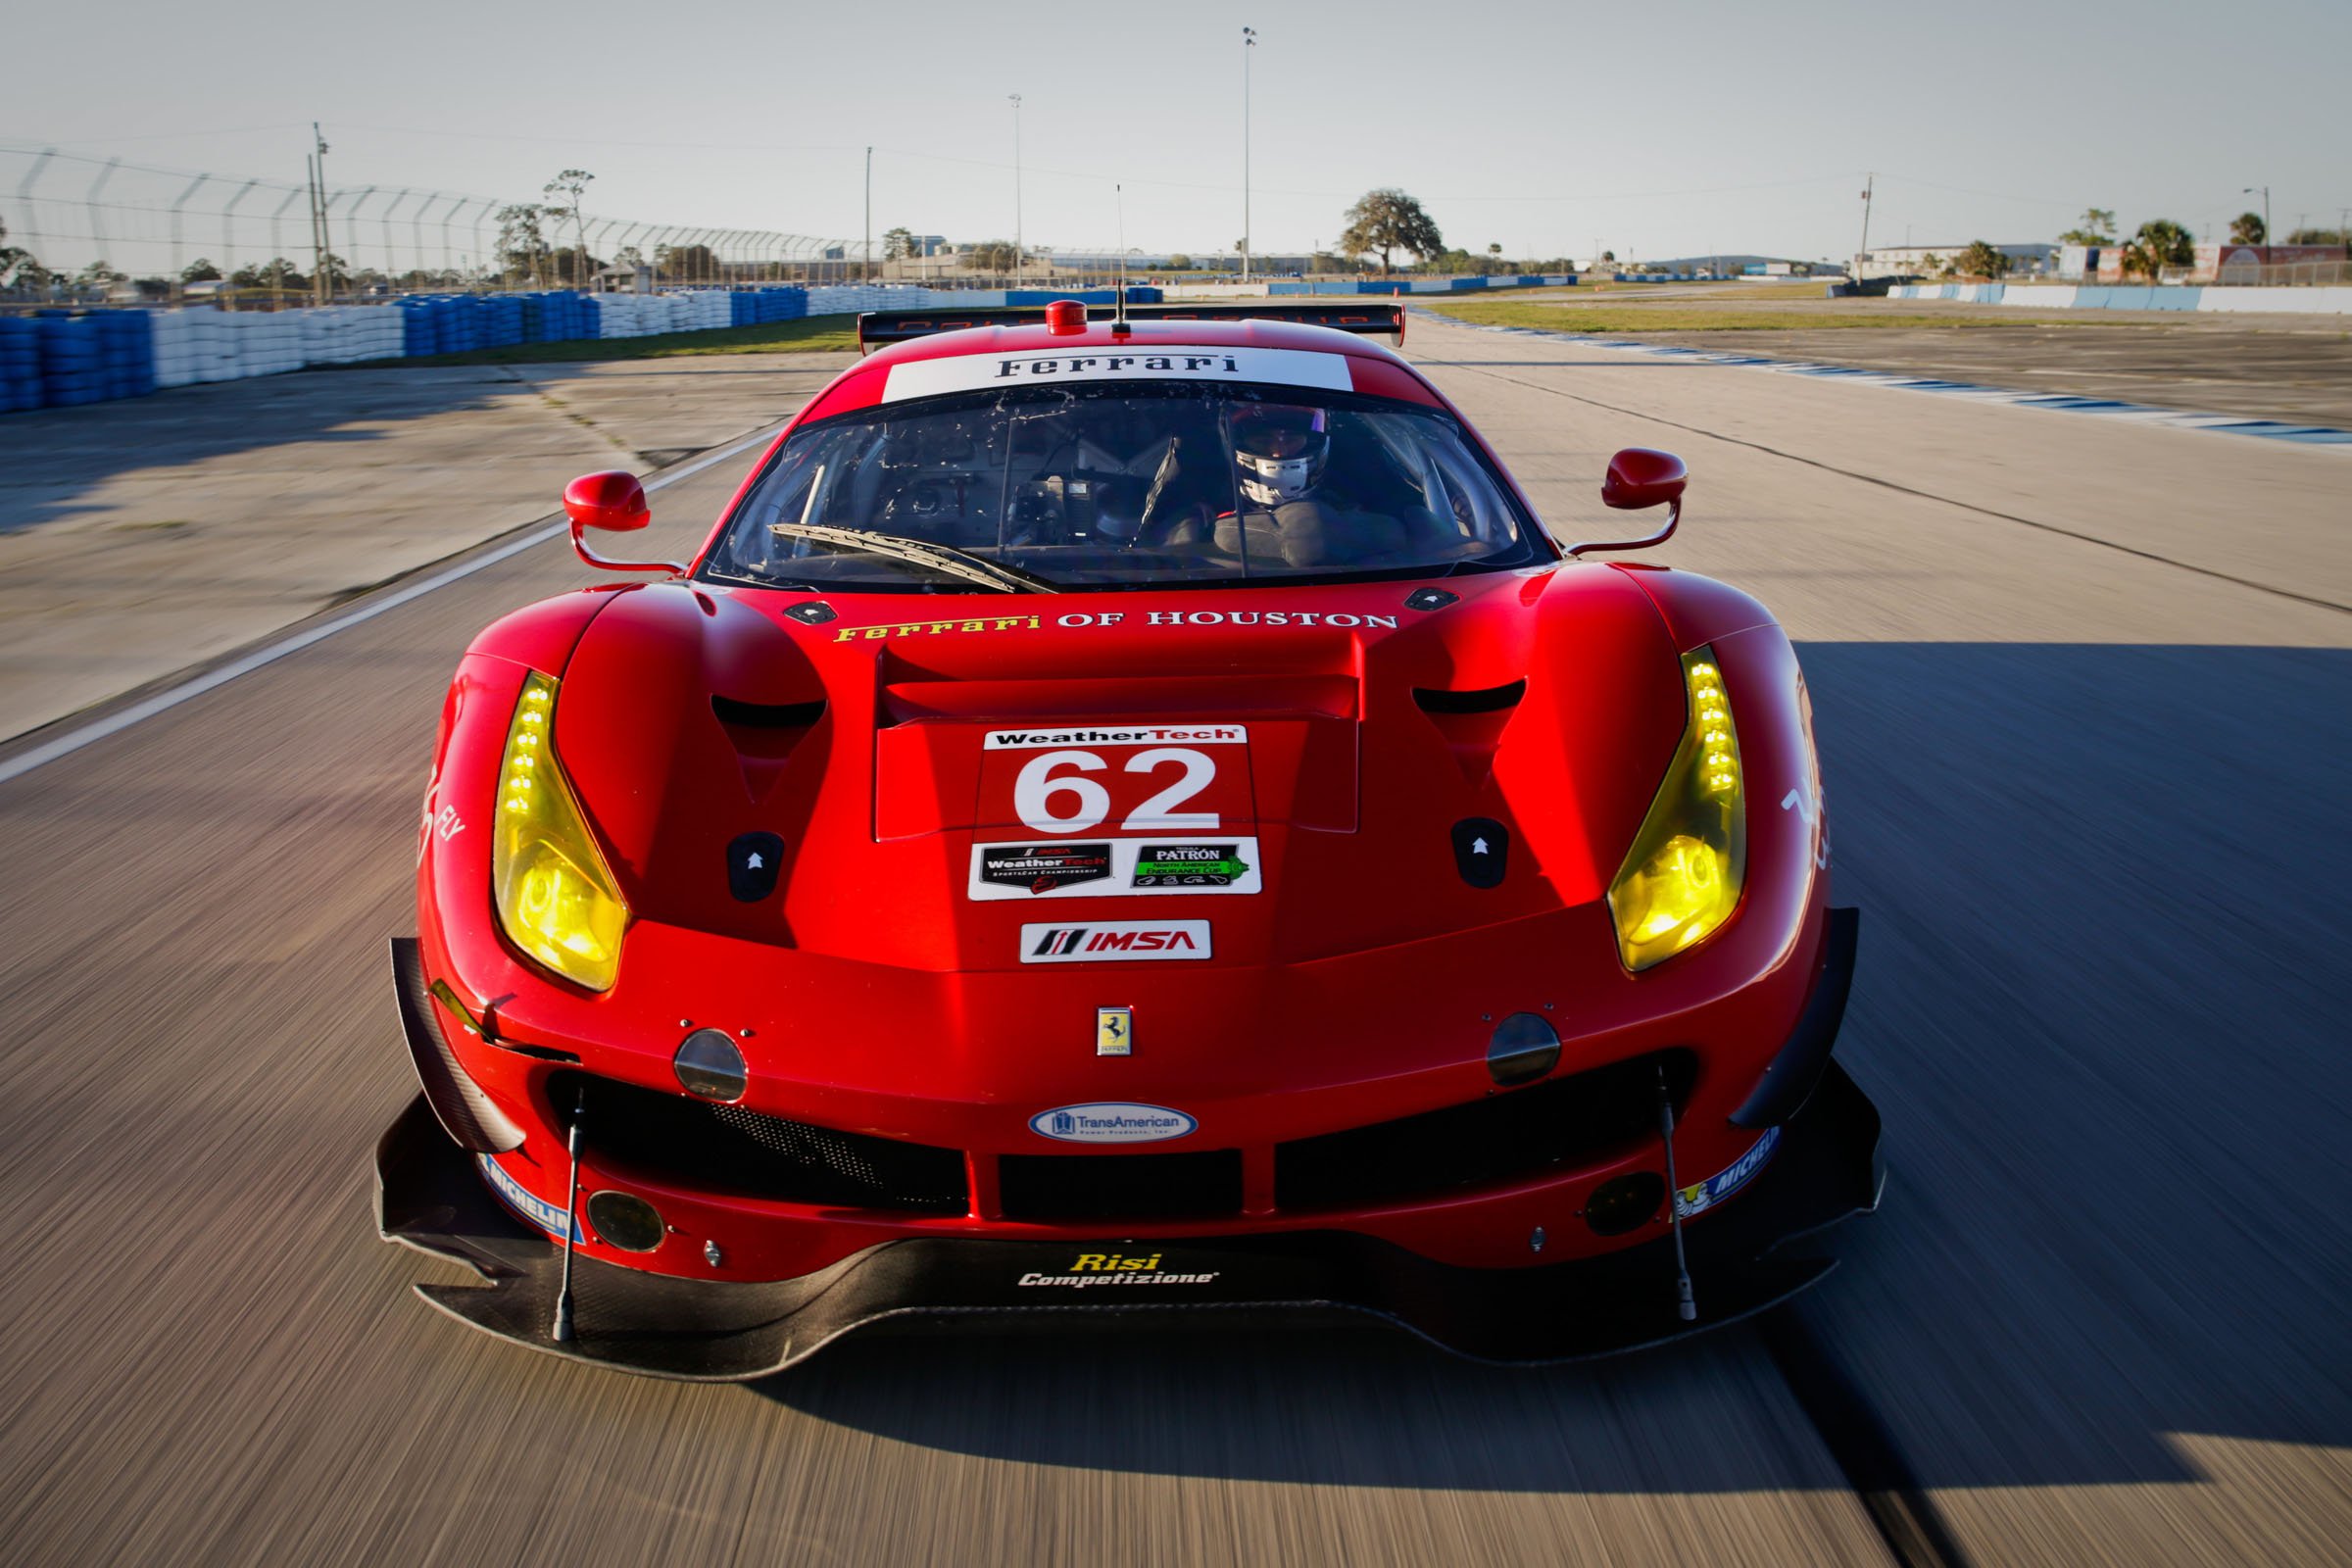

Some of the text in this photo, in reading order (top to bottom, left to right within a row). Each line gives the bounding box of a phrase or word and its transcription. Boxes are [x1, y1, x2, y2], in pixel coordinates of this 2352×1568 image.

[994, 354, 1240, 378] Ferrari
[833, 611, 1398, 643] Ferrari OF HOUSTON
[996, 728, 1236, 744] WeatherTech
[1013, 748, 1220, 834] 62
[1155, 848, 1220, 860] PATRÓN
[987, 857, 1107, 869] WeatherTech
[1085, 931, 1196, 952] IMSA
[1078, 1114, 1179, 1128] TransAmerican
[1069, 1253, 1162, 1272] Risi
[1018, 1272, 1214, 1288] Competizione
